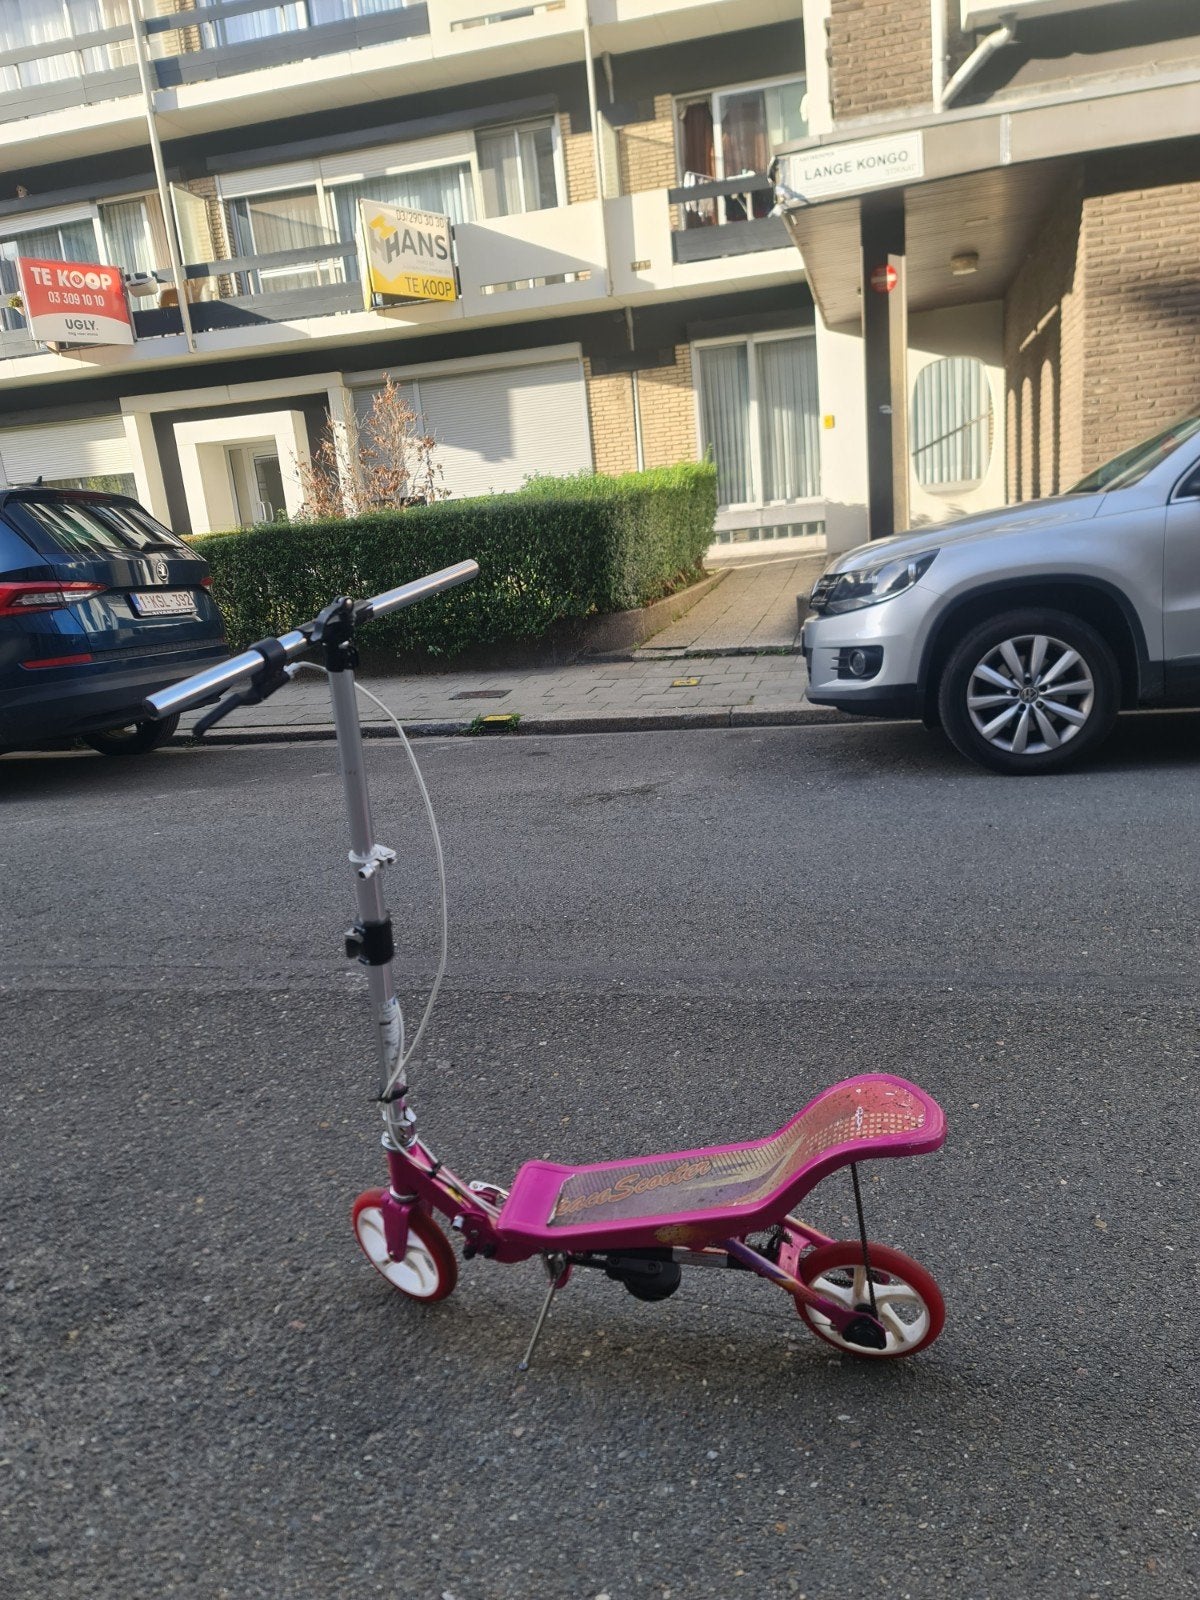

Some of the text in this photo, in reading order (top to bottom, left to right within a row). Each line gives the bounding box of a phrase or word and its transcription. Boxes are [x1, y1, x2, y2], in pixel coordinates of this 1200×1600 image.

[804, 161, 852, 181] LANGE
[856, 150, 909, 171] KONGO
[386, 229, 448, 264] HANS
[30, 266, 112, 290] TE KOOP
[404, 276, 452, 297] TE KOOP
[48, 291, 105, 307] 03 309 10 10
